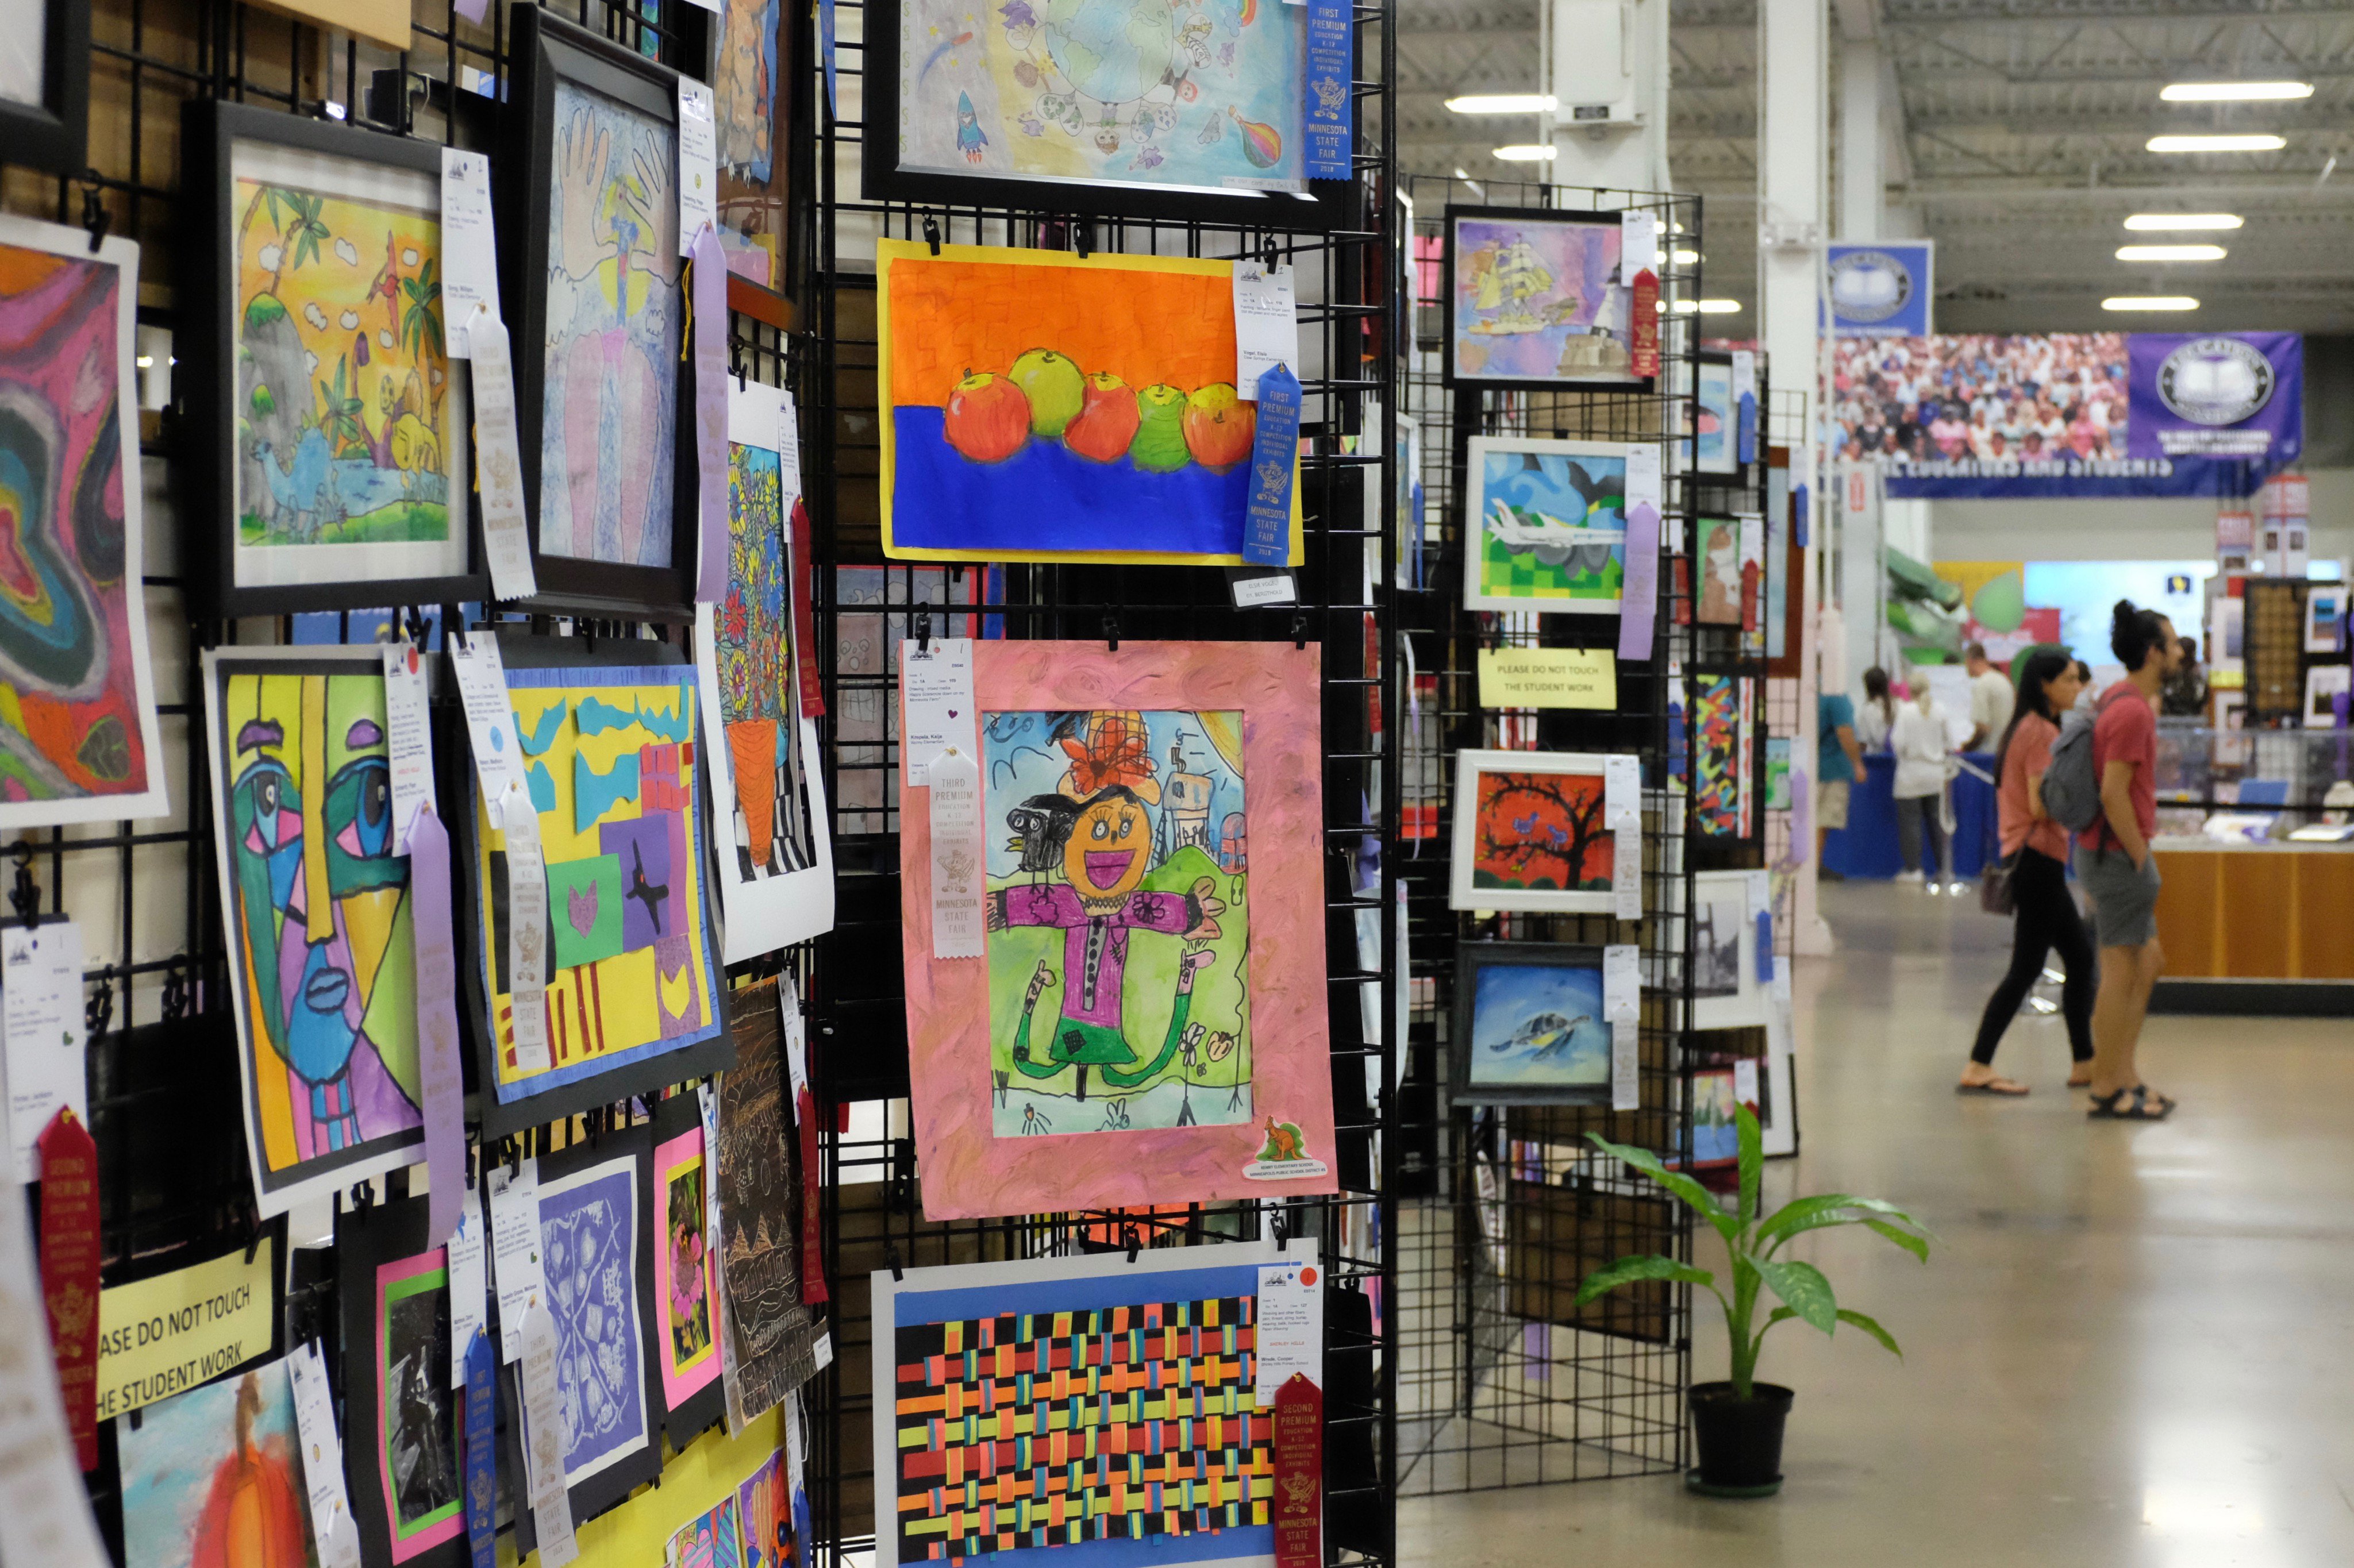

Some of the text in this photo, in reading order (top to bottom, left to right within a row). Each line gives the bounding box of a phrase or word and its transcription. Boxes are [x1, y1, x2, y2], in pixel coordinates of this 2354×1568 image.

[1318, 7, 1338, 18] FIRST
[1311, 18, 1346, 31] PREMIUM
[1314, 31, 1343, 40] EDUCATION
[1311, 48, 1346, 56] COMPETITION
[1314, 56, 1343, 65] INDIVIDUAL
[1317, 65, 1340, 73] EXHIBITS
[1308, 123, 1347, 135] MINNESOTA
[1316, 136, 1339, 147] STATE
[1319, 148, 1336, 159] FAIR
[1270, 391, 1289, 402] FIRST
[1262, 402, 1295, 417] PREMIUM
[1264, 414, 1291, 424] EDUCATION
[1260, 431, 1292, 442] COMPETITION
[1261, 439, 1288, 450] INDIVIDUAL
[1263, 448, 1284, 457] EXHIBITS
[2022, 459, 2067, 477] AND
[2068, 459, 2174, 478] STUDENTS
[1250, 505, 1286, 520] MINNESOTA
[1256, 519, 1278, 531] STATE
[1258, 531, 1274, 542] FAIR
[1259, 548, 1271, 556] 2018
[1497, 665, 1599, 675] PLEASE DO NOT TOUCH
[1505, 683, 1593, 692] THE STUDENT WORK
[942, 778, 966, 788] THIRD
[935, 791, 973, 801] PREMIUM
[936, 899, 977, 909] MINNESOTA
[944, 912, 969, 922] STATE
[948, 924, 966, 934] FAIR
[138, 1317, 163, 1347] DO
[168, 1303, 202, 1336] NOT
[206, 1283, 249, 1322] TOUCH
[97, 1389, 116, 1415] HE
[122, 1360, 197, 1408] STUDENT
[201, 1340, 242, 1378] WORK
[1283, 1403, 1313, 1413] SECOND
[1281, 1415, 1316, 1426] PREMIUM
[1280, 1443, 1316, 1451] COMPETITION
[537, 1485, 565, 1511] MINNESOTA
[543, 1505, 560, 1524] STATE
[1279, 1517, 1317, 1529] MINNESOTA
[548, 1523, 561, 1539] FAIR
[1286, 1530, 1309, 1541] STATE
[1290, 1543, 1306, 1552] FAIR
